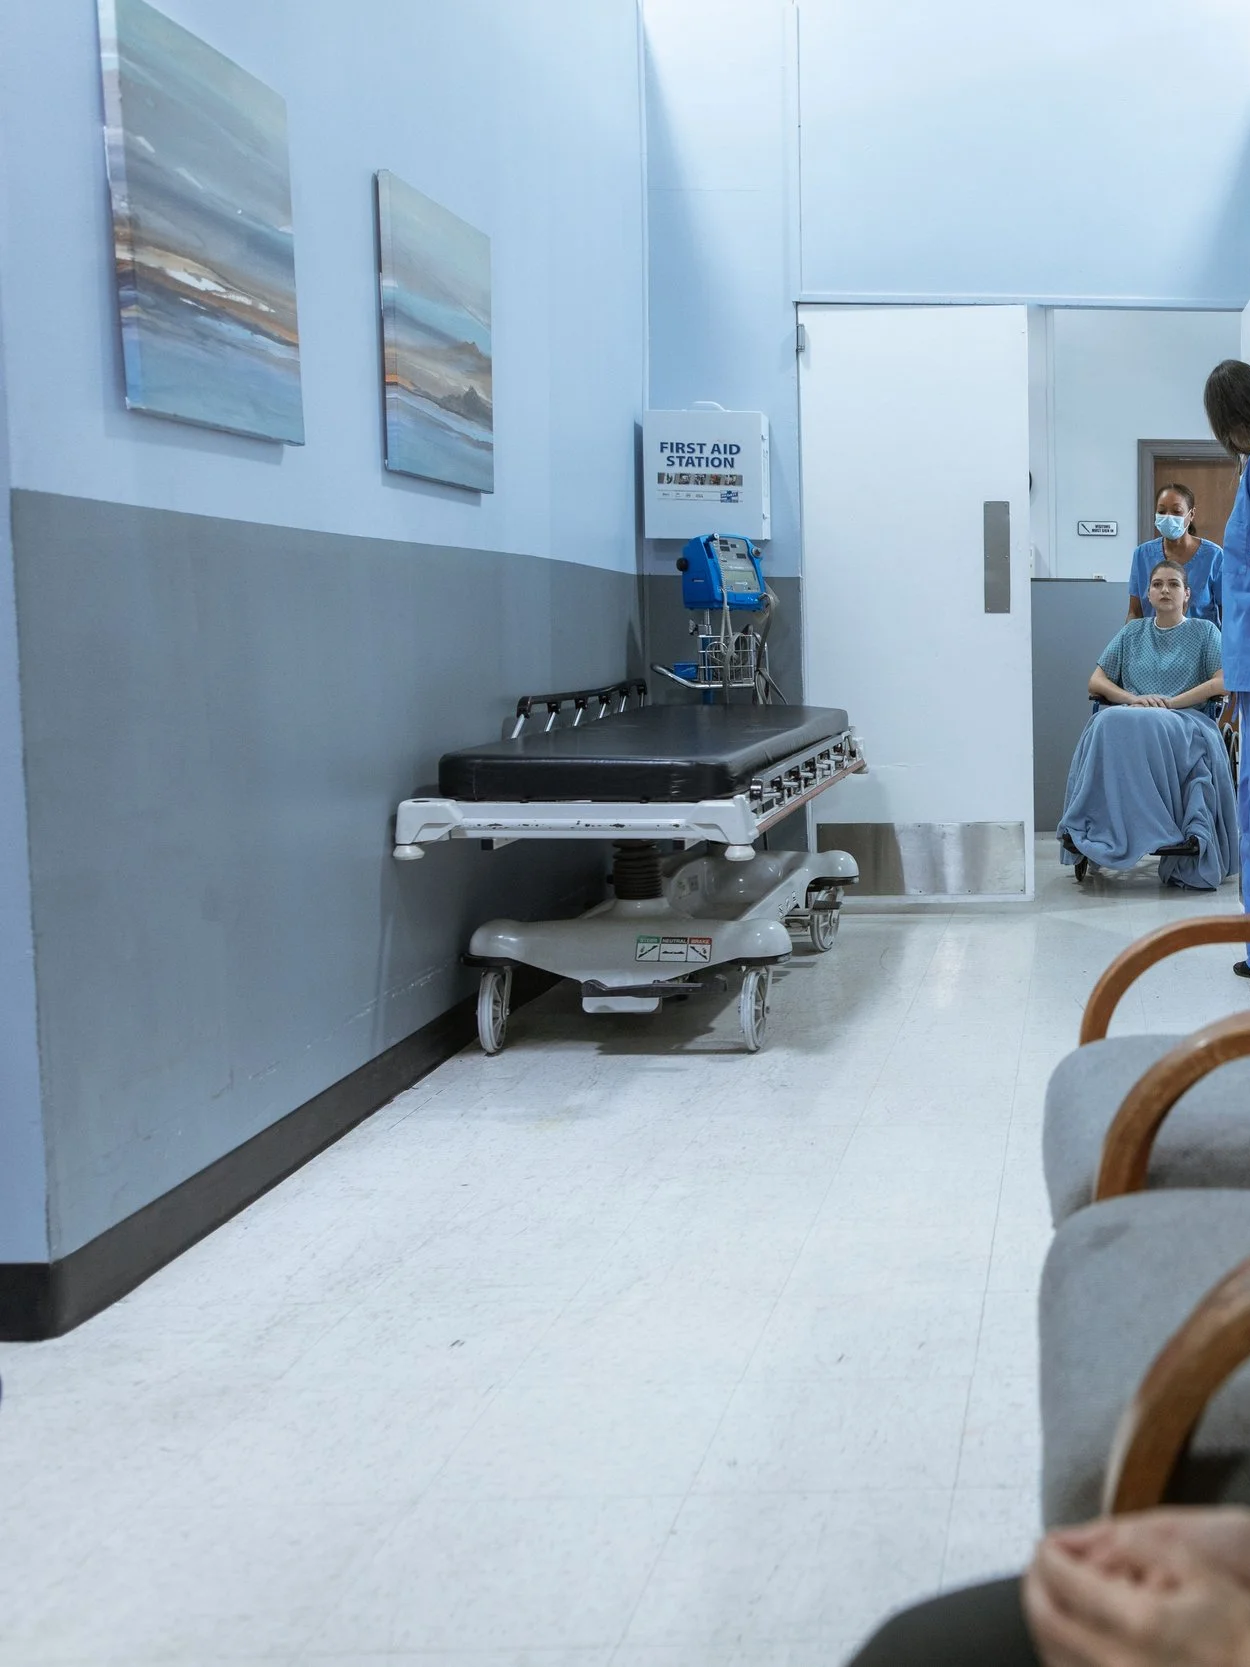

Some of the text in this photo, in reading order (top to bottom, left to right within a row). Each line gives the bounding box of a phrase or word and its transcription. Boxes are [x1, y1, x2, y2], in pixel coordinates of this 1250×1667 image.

[659, 441, 741, 455] FIRST AID
[666, 455, 735, 468] STATION
